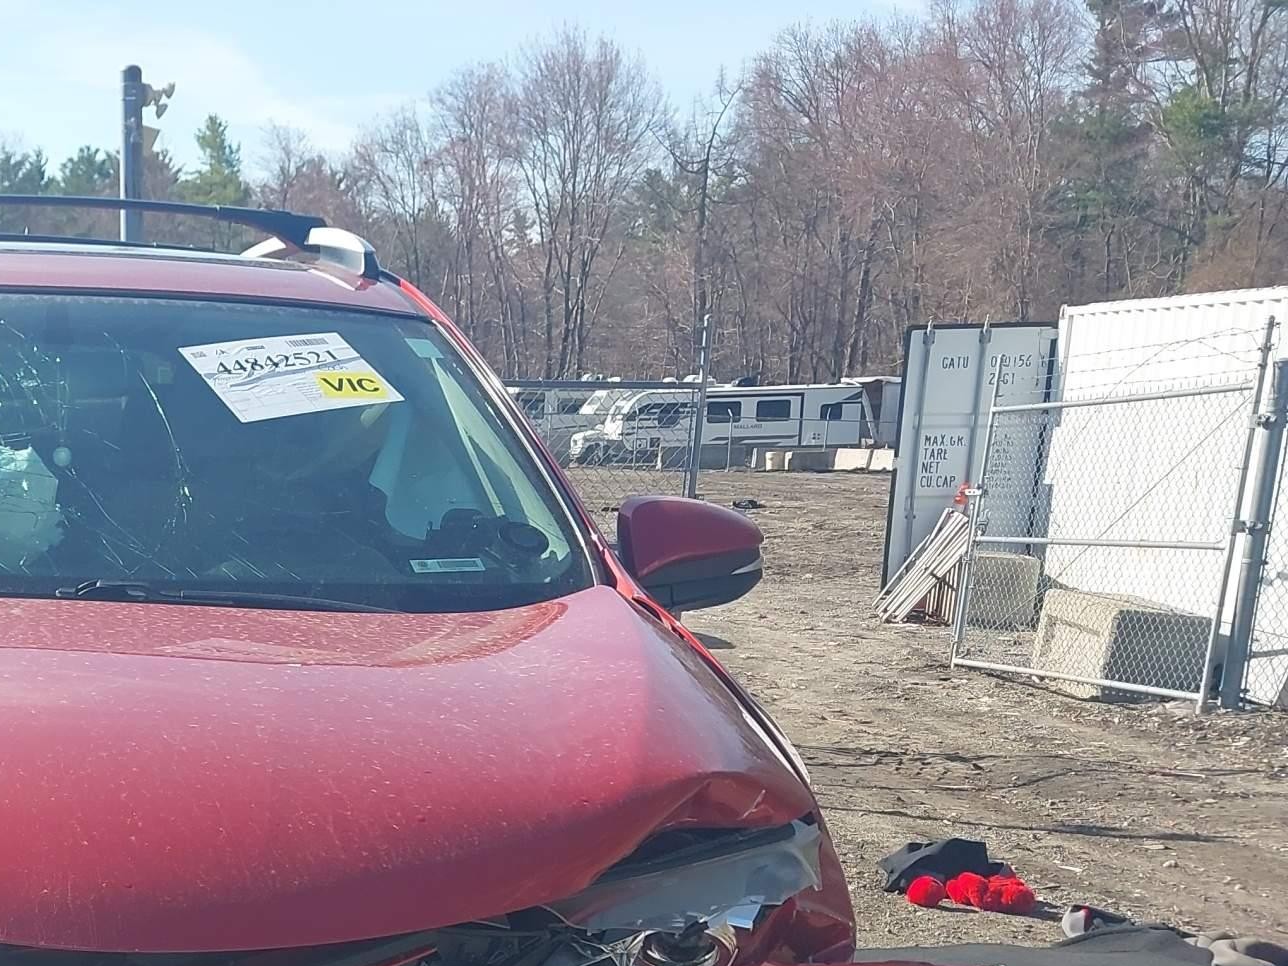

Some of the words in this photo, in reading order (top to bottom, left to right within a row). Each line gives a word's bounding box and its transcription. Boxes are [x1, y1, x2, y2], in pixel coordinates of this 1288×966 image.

[216, 349, 338, 375] 44842521
[942, 356, 969, 369] GATU
[319, 377, 380, 393] VIC
[923, 447, 948, 460] TARE
[921, 461, 940, 474] NET
